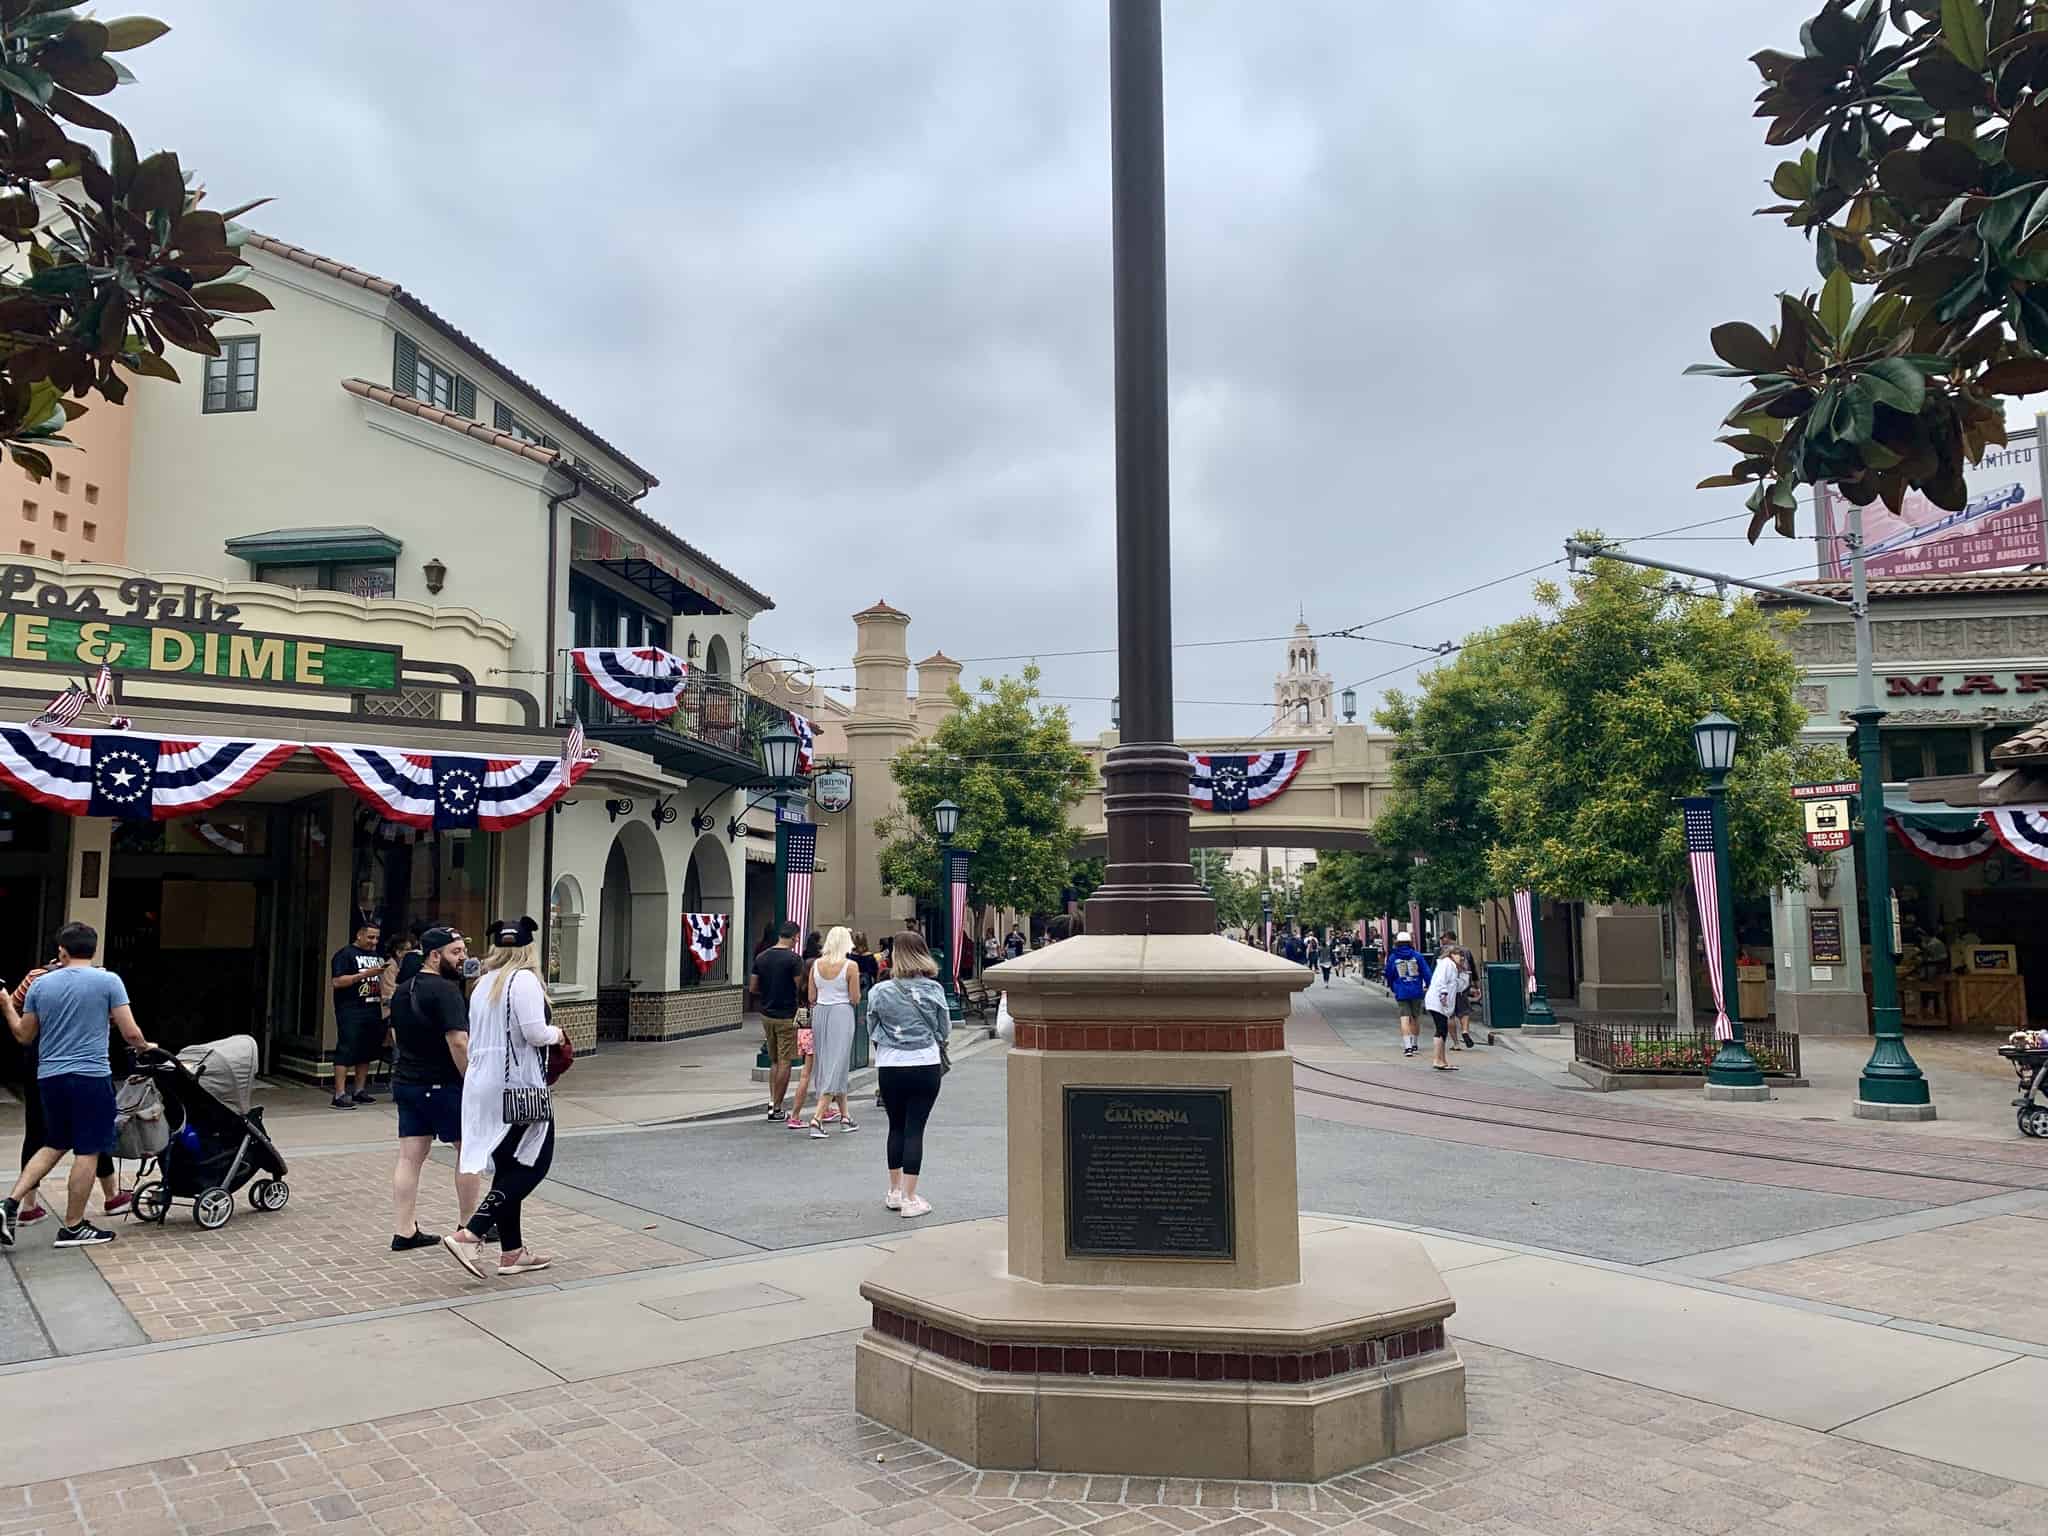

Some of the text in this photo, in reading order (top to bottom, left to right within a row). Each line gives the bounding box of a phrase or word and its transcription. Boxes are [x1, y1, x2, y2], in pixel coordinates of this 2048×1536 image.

[1927, 533, 2040, 558] FIRST CLASS TRAVEL
[1895, 559, 1933, 574] KANSAS
[1938, 556, 1960, 568] CITY
[1971, 553, 1990, 564] LOS
[1996, 546, 2041, 561] ANGELES
[118, 576, 244, 632] Feliz
[75, 622, 127, 666] &
[148, 626, 327, 686] DIME
[1794, 783, 1857, 796] BUENA VISTA STREET
[1812, 839, 1845, 847] TROLLEY
[1105, 1106, 1189, 1124] CALIFORNIA
